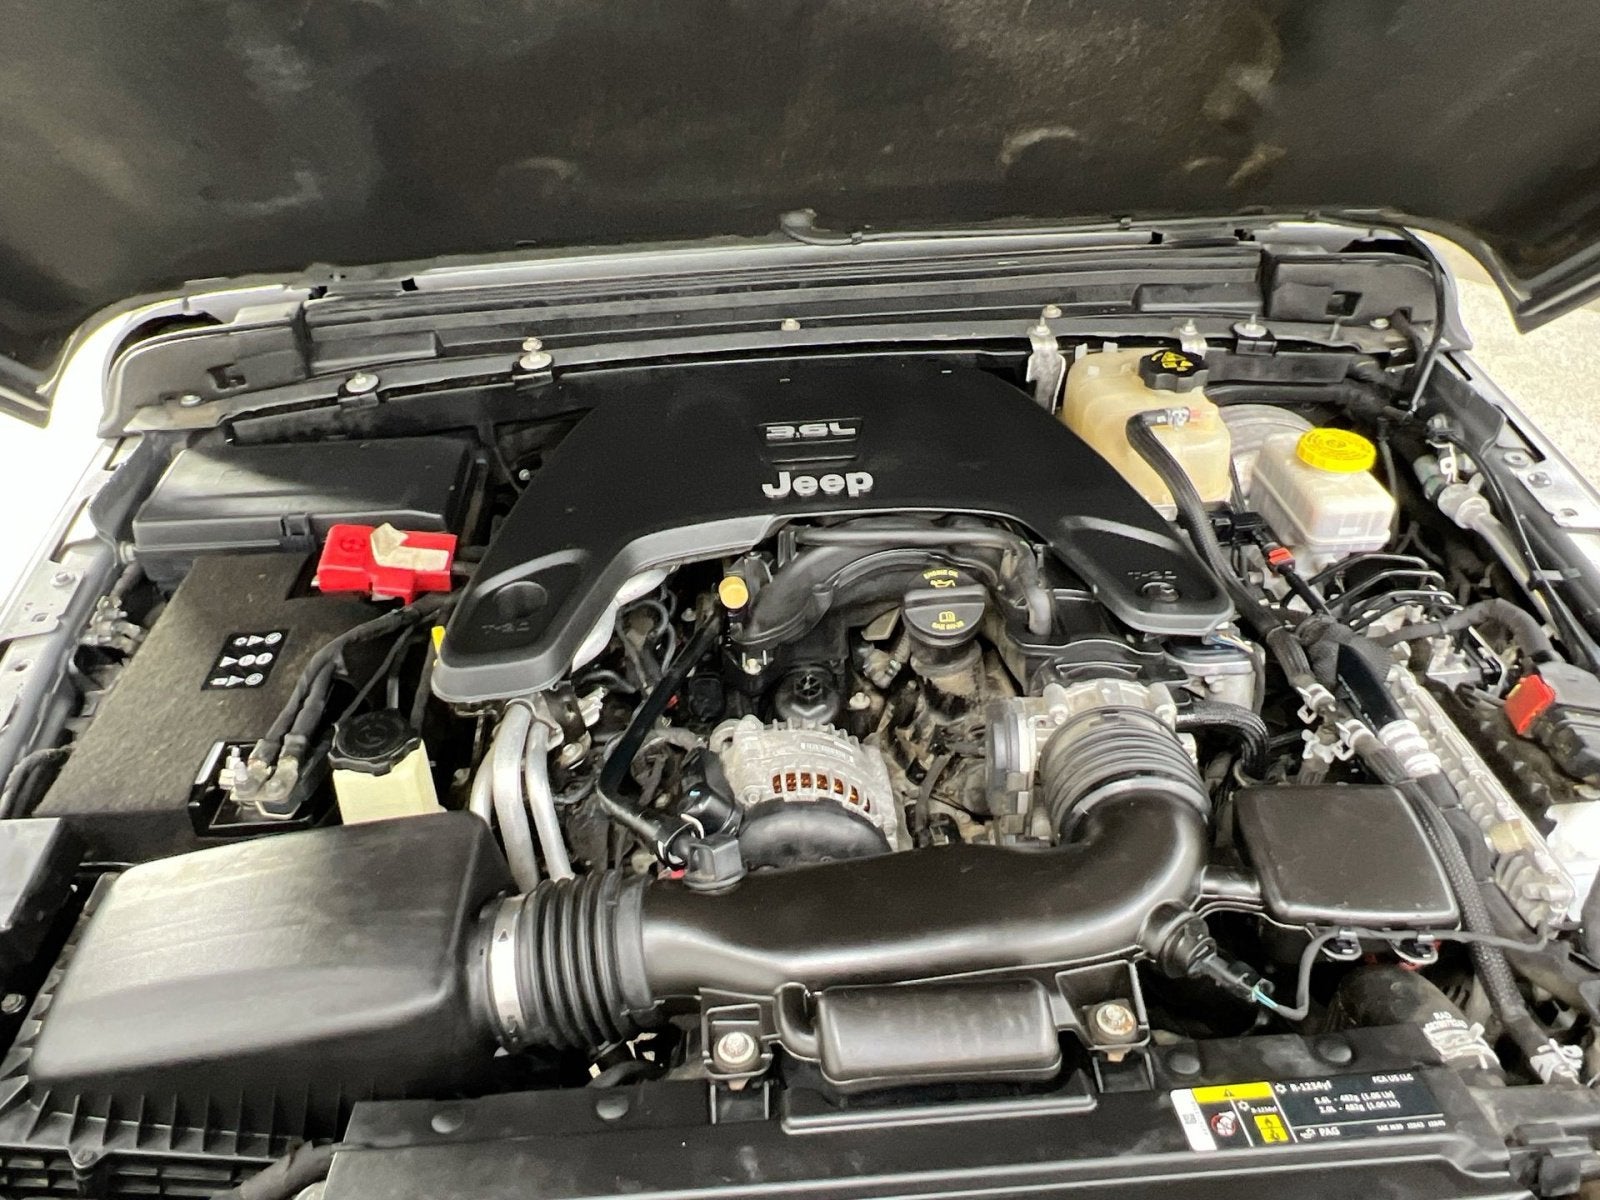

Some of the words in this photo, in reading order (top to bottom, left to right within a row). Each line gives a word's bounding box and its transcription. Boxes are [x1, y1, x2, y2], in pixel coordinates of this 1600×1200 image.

[766, 422, 856, 440] 3.6L
[761, 471, 874, 499] Jeep
[923, 569, 948, 580] ENGINE
[948, 569, 959, 578] OIL
[1289, 1079, 1332, 1092] R-1234yf
[1372, 1075, 1388, 1084] FCA
[1318, 1126, 1341, 1136] PAG
